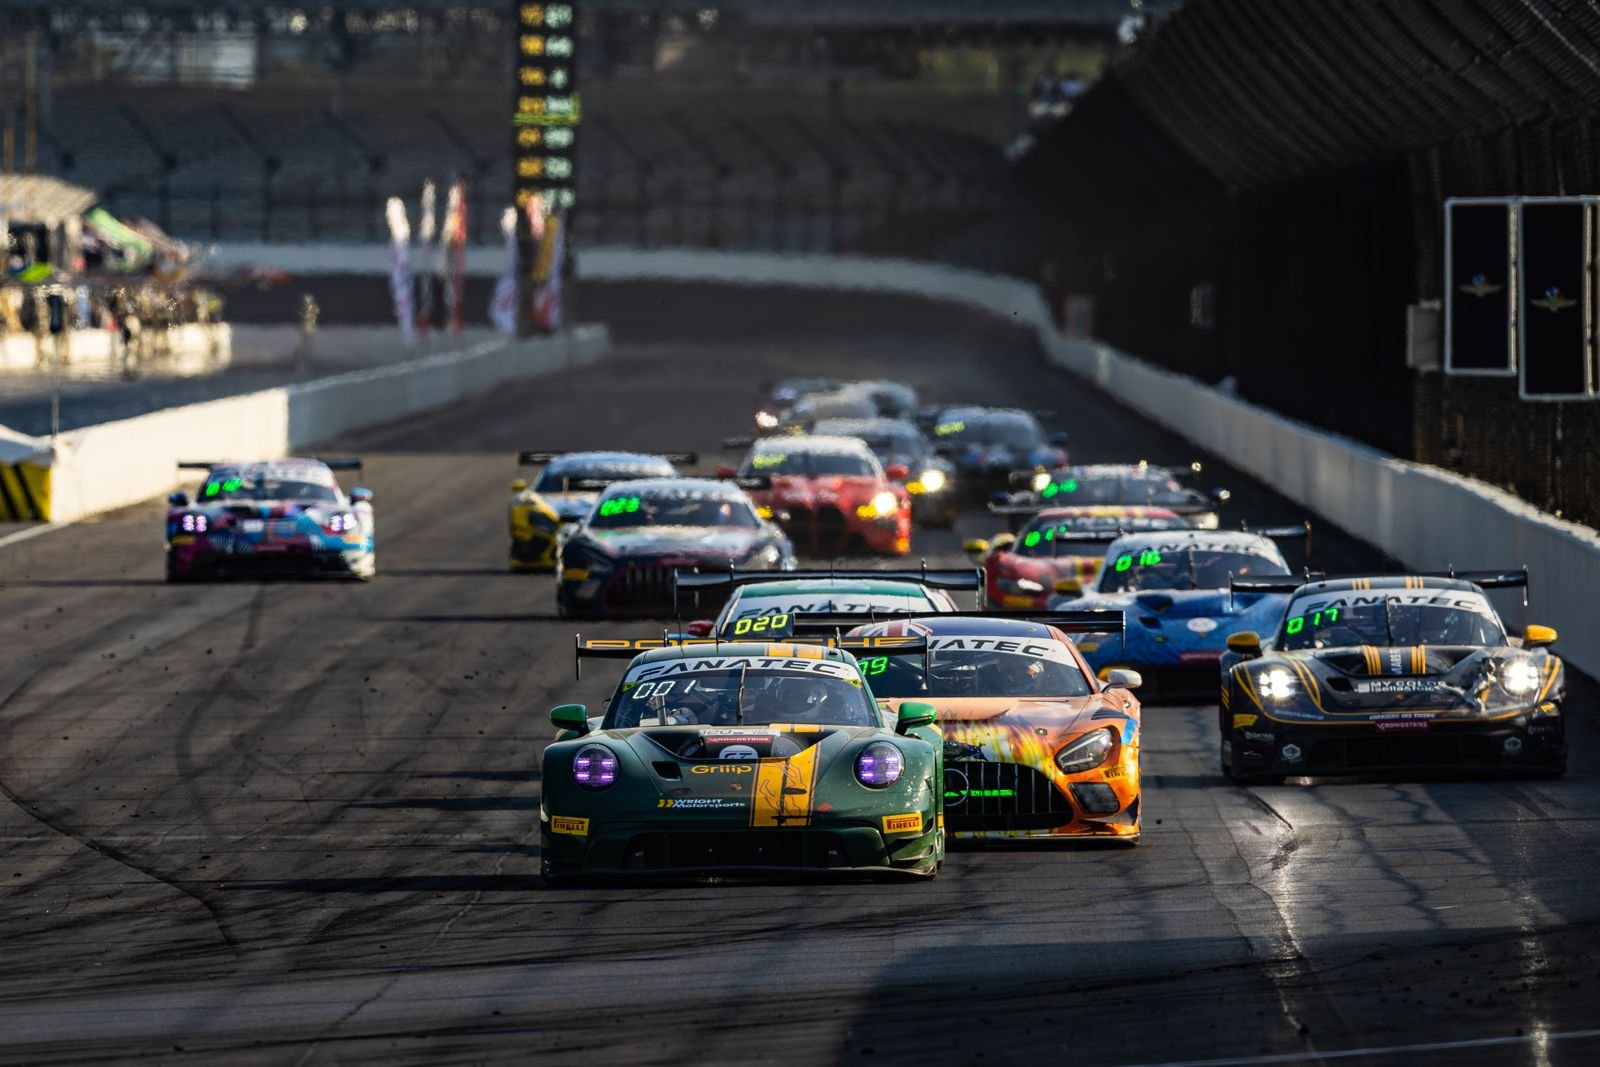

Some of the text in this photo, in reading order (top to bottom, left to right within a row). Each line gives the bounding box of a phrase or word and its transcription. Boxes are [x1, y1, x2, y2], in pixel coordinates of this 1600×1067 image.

[1304, 596, 1477, 614] FANATEC
[734, 614, 788, 635] 020
[1286, 608, 1338, 634] 017
[636, 659, 841, 682] FANATEC
[554, 818, 586, 831] PIRELLI
[887, 816, 920, 829] PIRELLI
